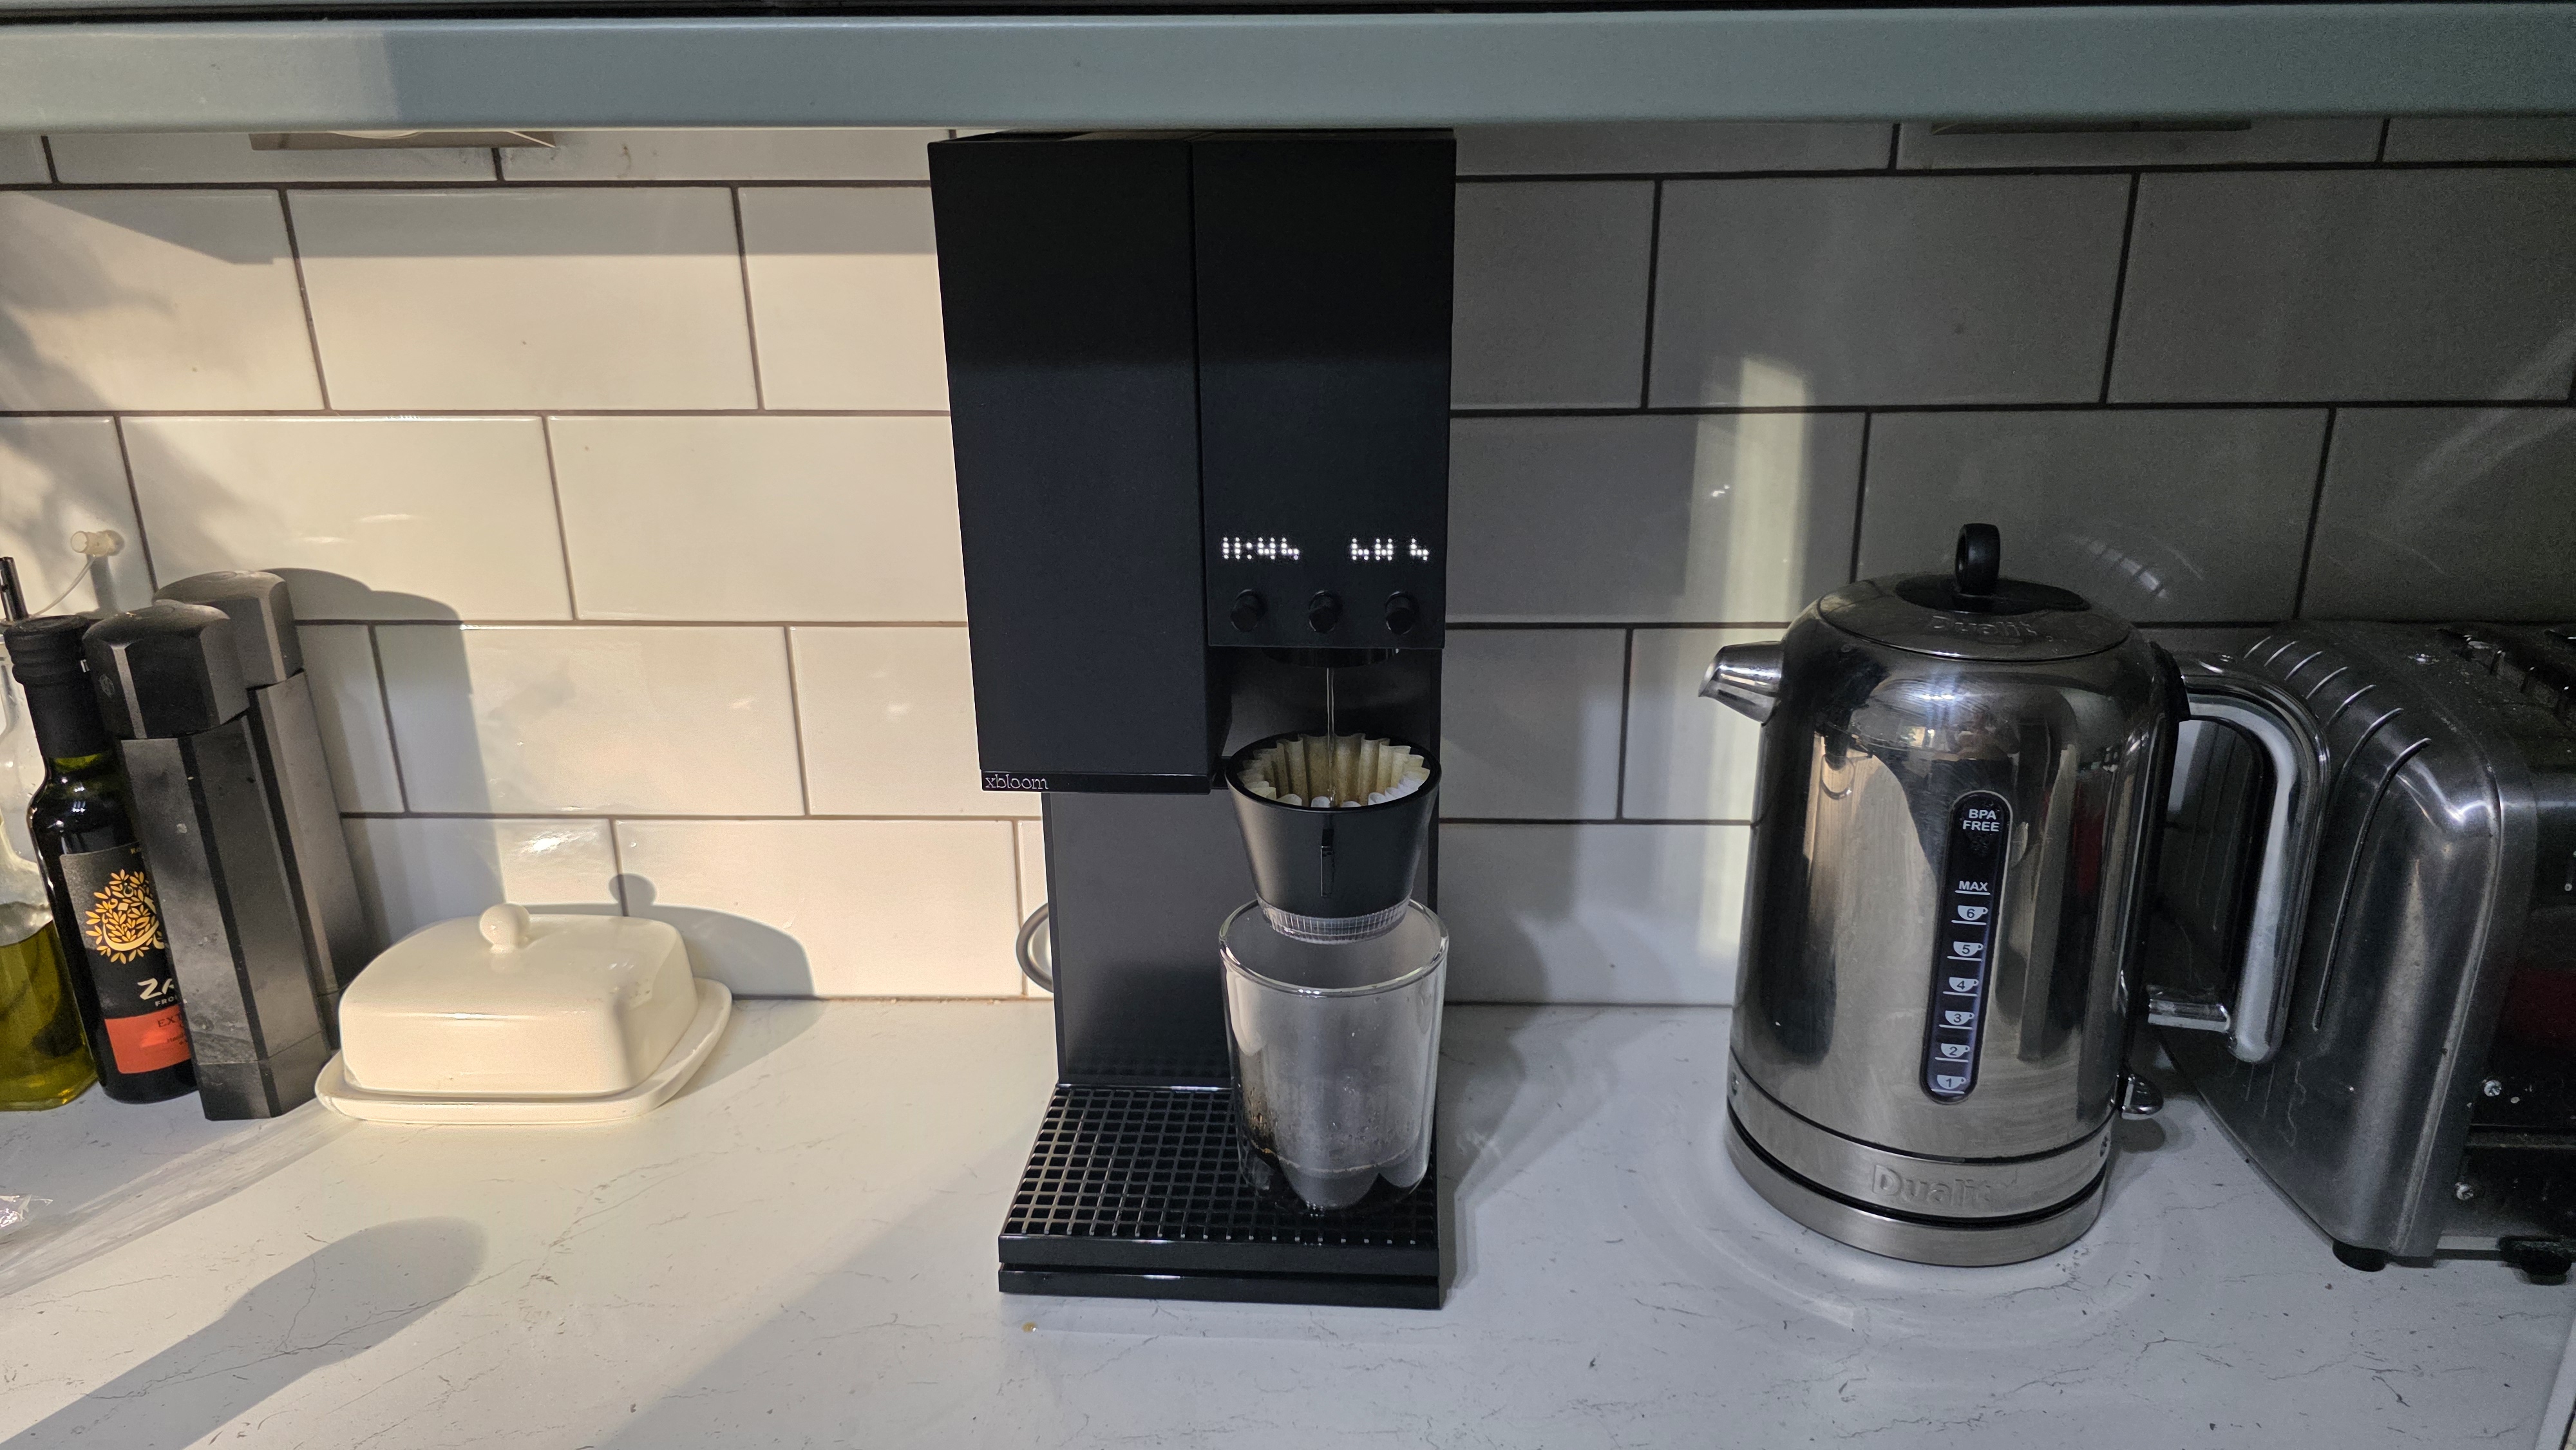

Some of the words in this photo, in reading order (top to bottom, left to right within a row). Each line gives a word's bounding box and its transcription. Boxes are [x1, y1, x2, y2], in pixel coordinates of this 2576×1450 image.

[985, 773, 1049, 790] xbloom
[1968, 809, 1996, 820] BPA
[1962, 820, 2000, 832] FREE
[1958, 880, 1988, 892] MAX
[1966, 908, 1975, 919] 6
[1961, 944, 1971, 955] 5
[1956, 980, 1965, 991] 4
[155, 995, 177, 1007] FRO
[1953, 1013, 1962, 1023] 3
[1949, 1046, 1958, 1057] 2
[1946, 1078, 1953, 1088] 1
